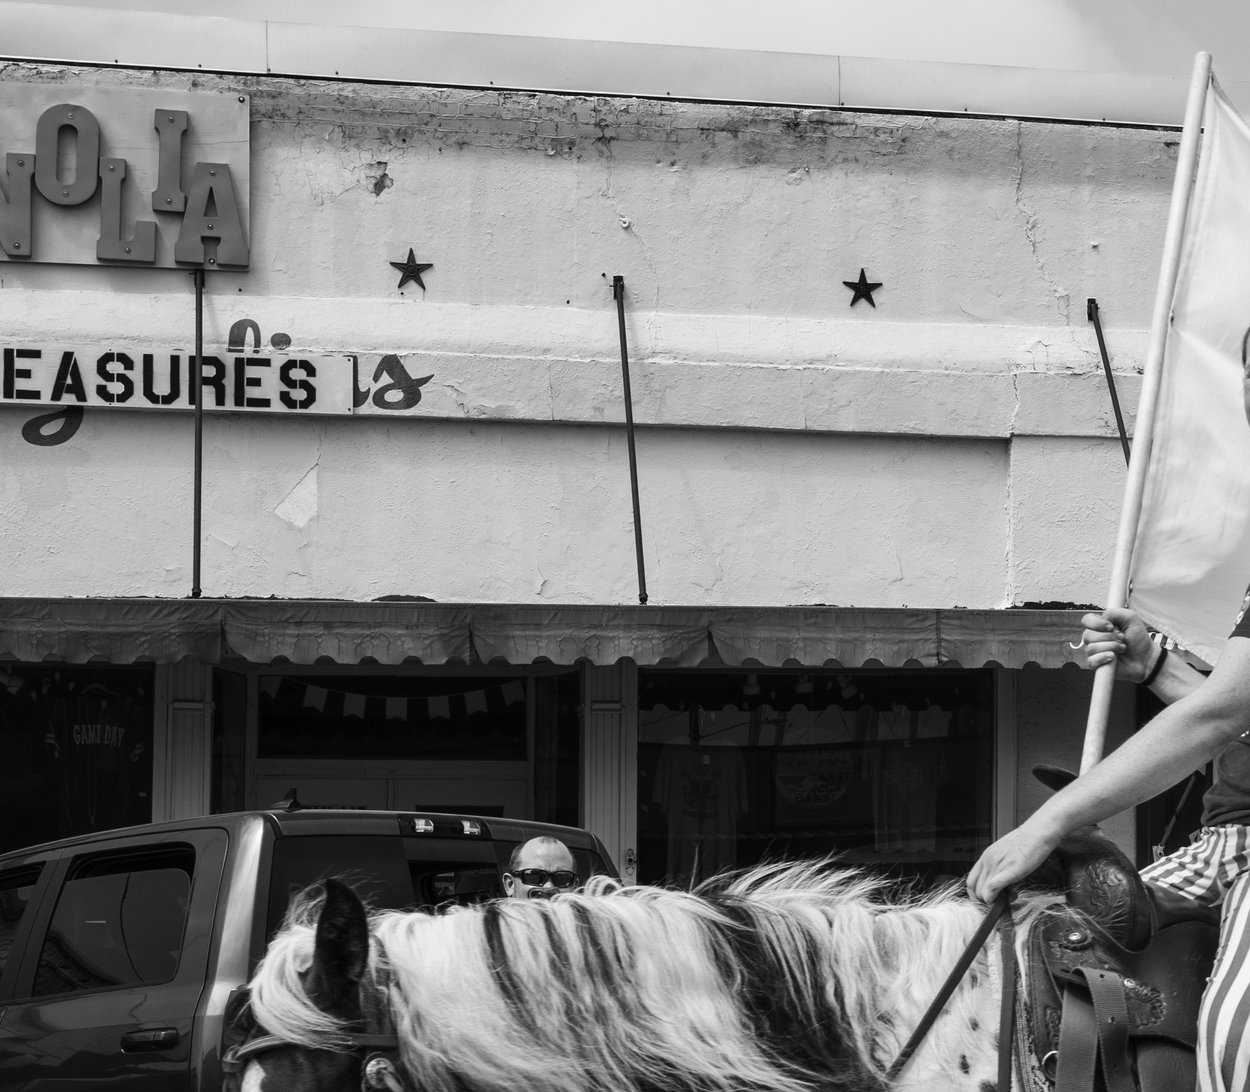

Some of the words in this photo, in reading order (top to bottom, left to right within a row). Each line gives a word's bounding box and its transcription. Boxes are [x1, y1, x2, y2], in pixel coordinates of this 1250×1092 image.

[3, 348, 317, 410] EASURES
[73, 724, 102, 745] GAME
[104, 724, 126, 747] DAY
